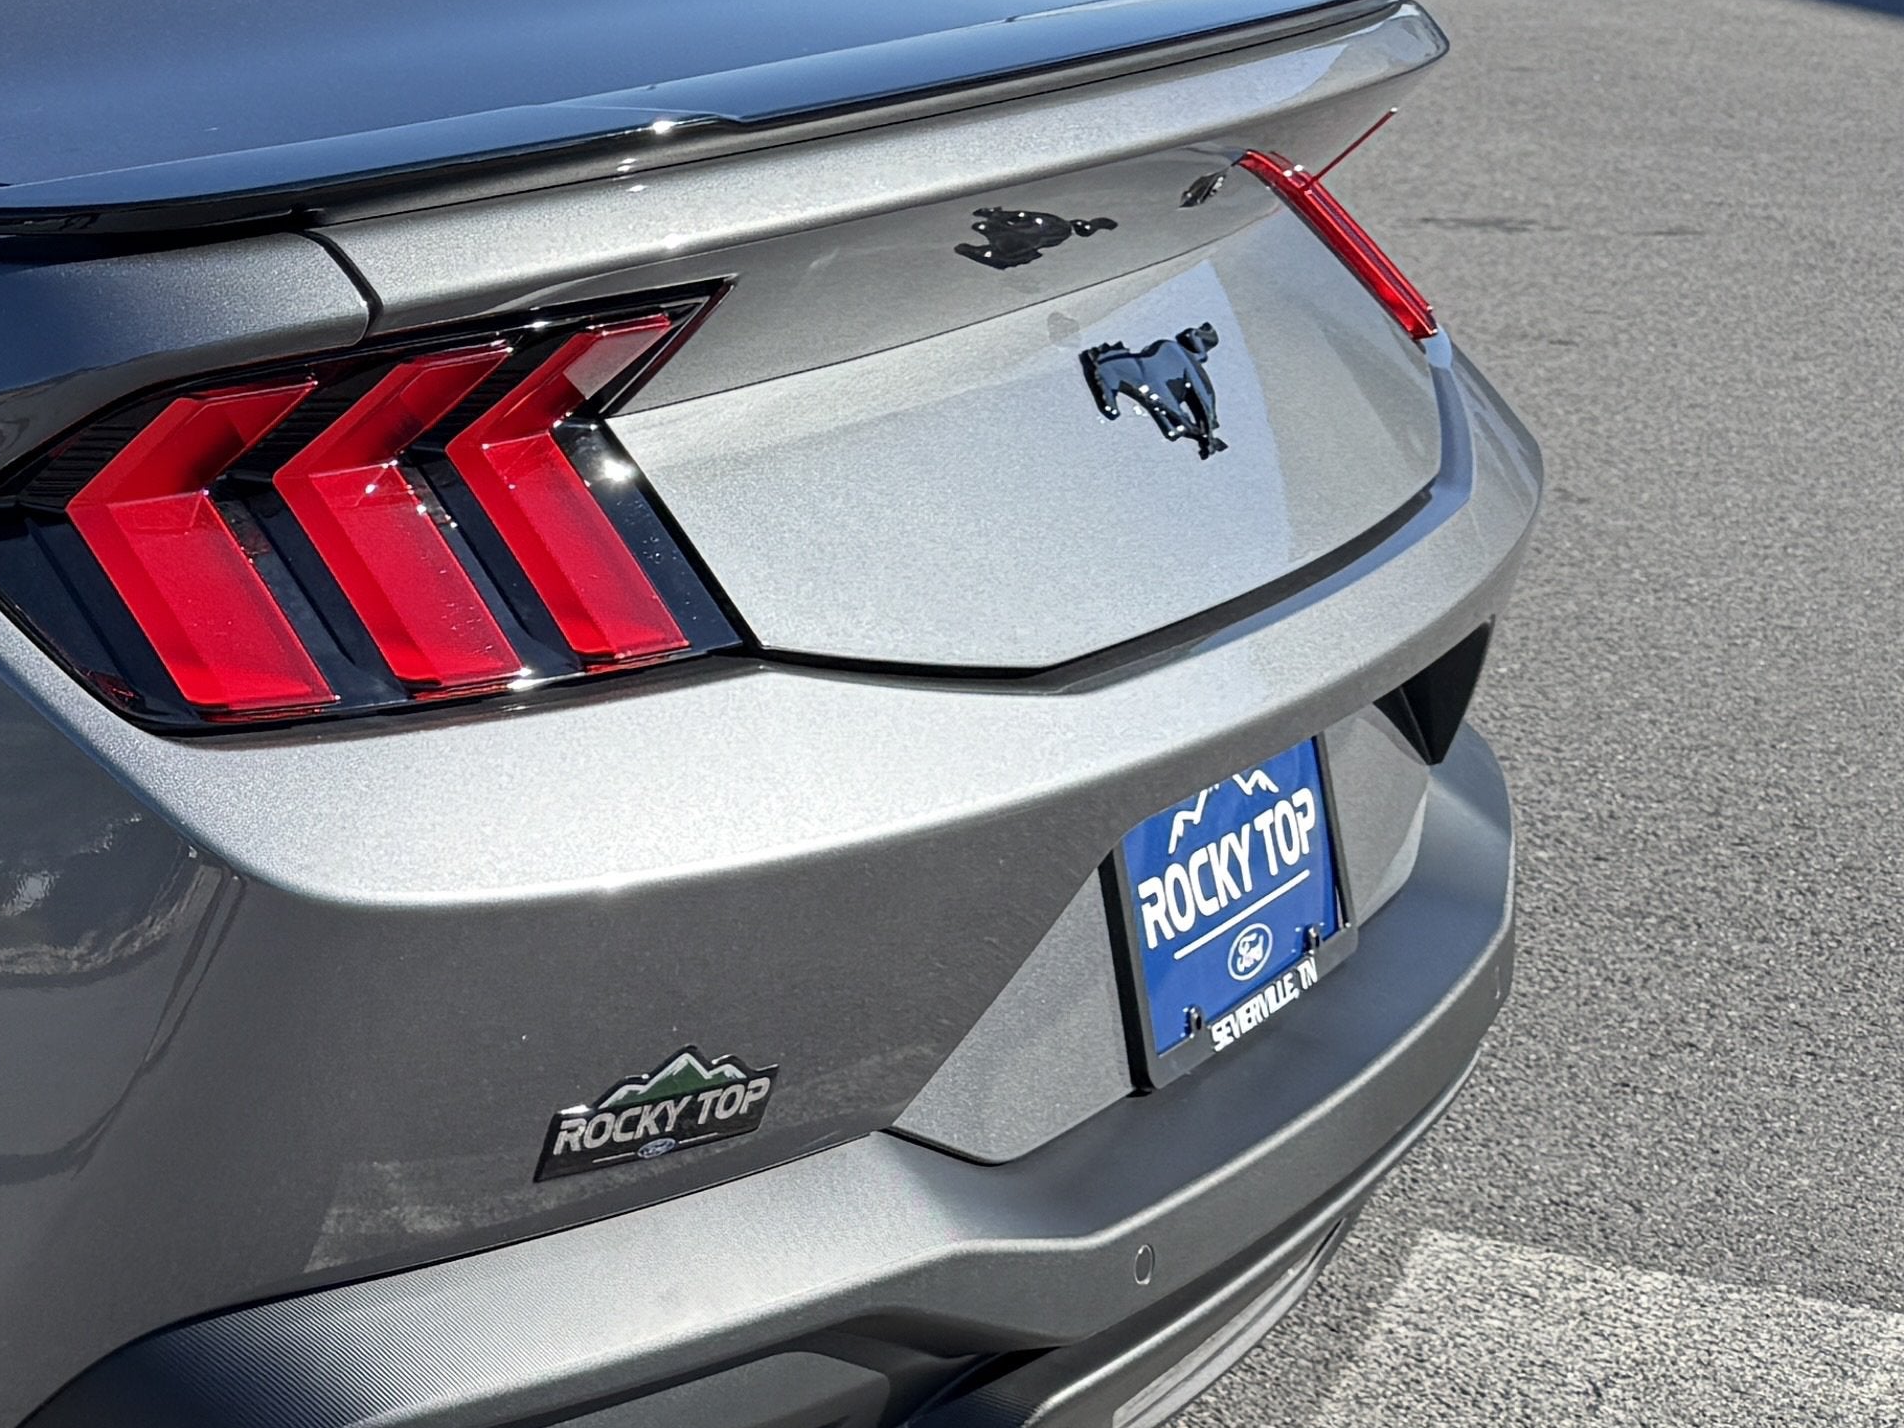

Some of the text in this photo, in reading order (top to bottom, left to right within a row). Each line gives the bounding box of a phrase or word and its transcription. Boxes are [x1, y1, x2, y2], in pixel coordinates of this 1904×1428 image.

[1137, 787, 1316, 949] ROCKY TOP
[1296, 956, 1318, 990] TN
[553, 1095, 692, 1156] ROCKY
[696, 1077, 771, 1125] TOP
